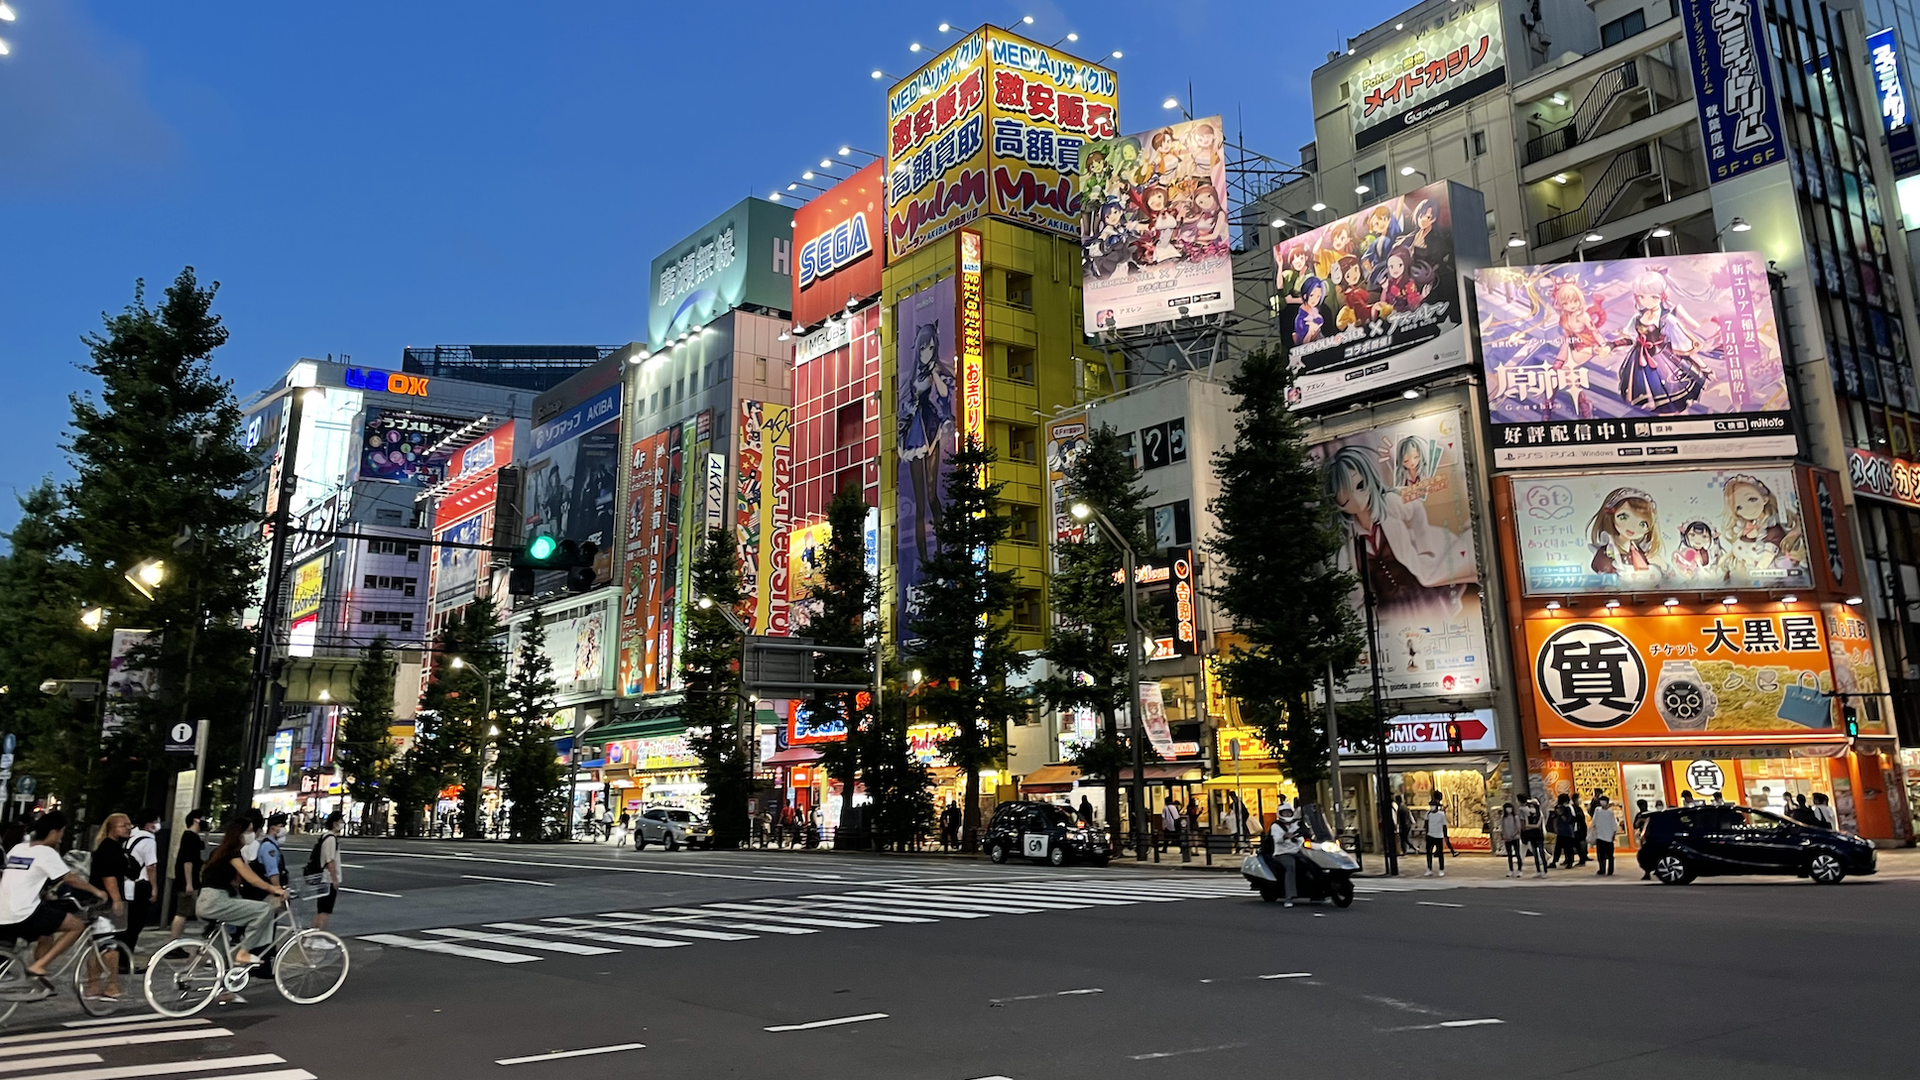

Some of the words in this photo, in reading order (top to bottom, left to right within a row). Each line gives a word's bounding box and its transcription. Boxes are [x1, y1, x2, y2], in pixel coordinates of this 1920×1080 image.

[1364, 35, 1490, 118] メイドカジノ
[892, 67, 983, 157] 激安販売
[994, 70, 1114, 138] 激安販売
[993, 118, 1079, 175] 高額買
[1706, 104, 1726, 160] 秋葉原店
[891, 114, 983, 206] 高額買取
[890, 170, 987, 256] Mulan
[926, 227, 947, 241] AKIBA
[799, 212, 873, 288] SEGA
[1494, 347, 1590, 416] 原神
[546, 411, 582, 441] ソフマップ
[587, 397, 613, 422] AKIBA
[1504, 422, 1628, 444] 好評配信中!
[633, 449, 646, 469] 4F
[709, 457, 723, 510] AKKY
[629, 517, 641, 540] 3F
[1533, 524, 1575, 536] バーチャル
[1546, 552, 1569, 561] カフェ
[624, 593, 637, 617] 2F
[1176, 580, 1193, 642] 吉野家
[1649, 644, 1698, 658] チケット
[1702, 617, 1821, 654] 大黒屋
[1551, 640, 1640, 718] 質
[1690, 764, 1720, 792] 質
